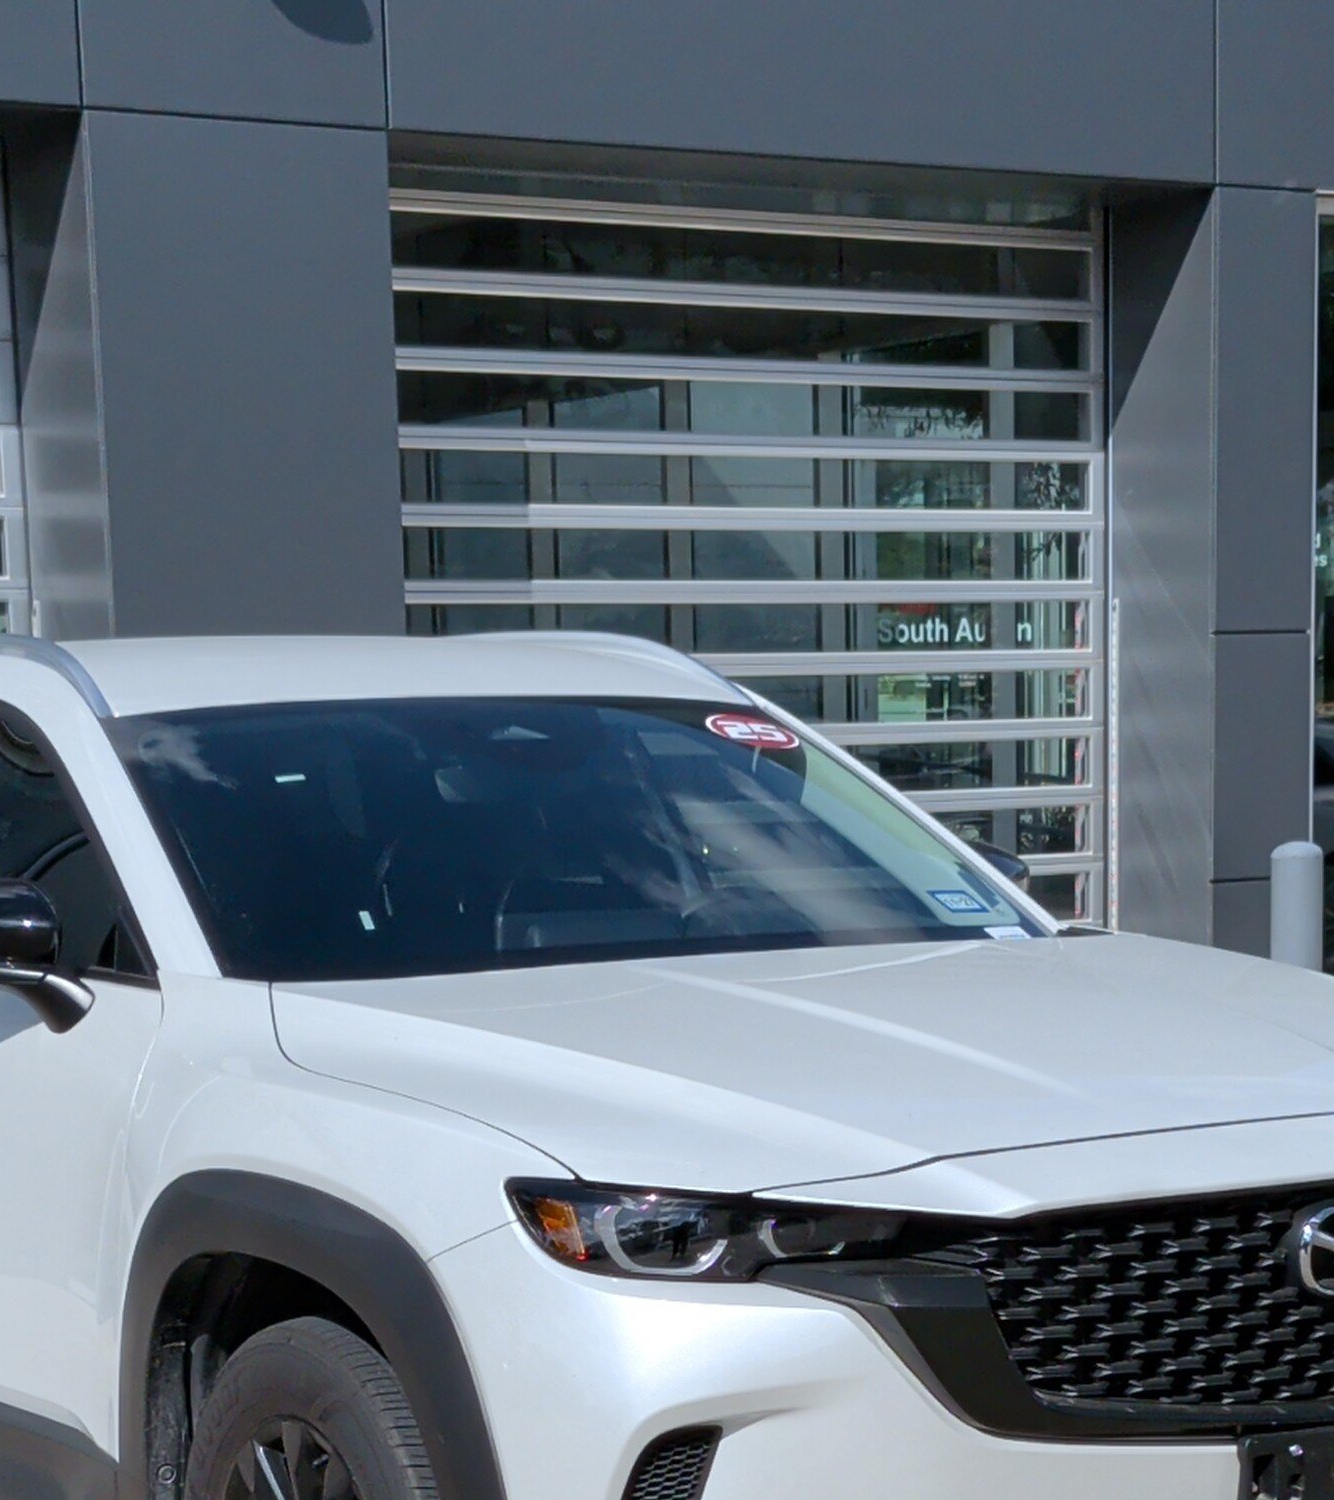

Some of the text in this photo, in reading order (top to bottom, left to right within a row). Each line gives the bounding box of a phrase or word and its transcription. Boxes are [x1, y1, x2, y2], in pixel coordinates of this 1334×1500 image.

[878, 616, 1033, 644] South Aun
[716, 719, 788, 742] 25
